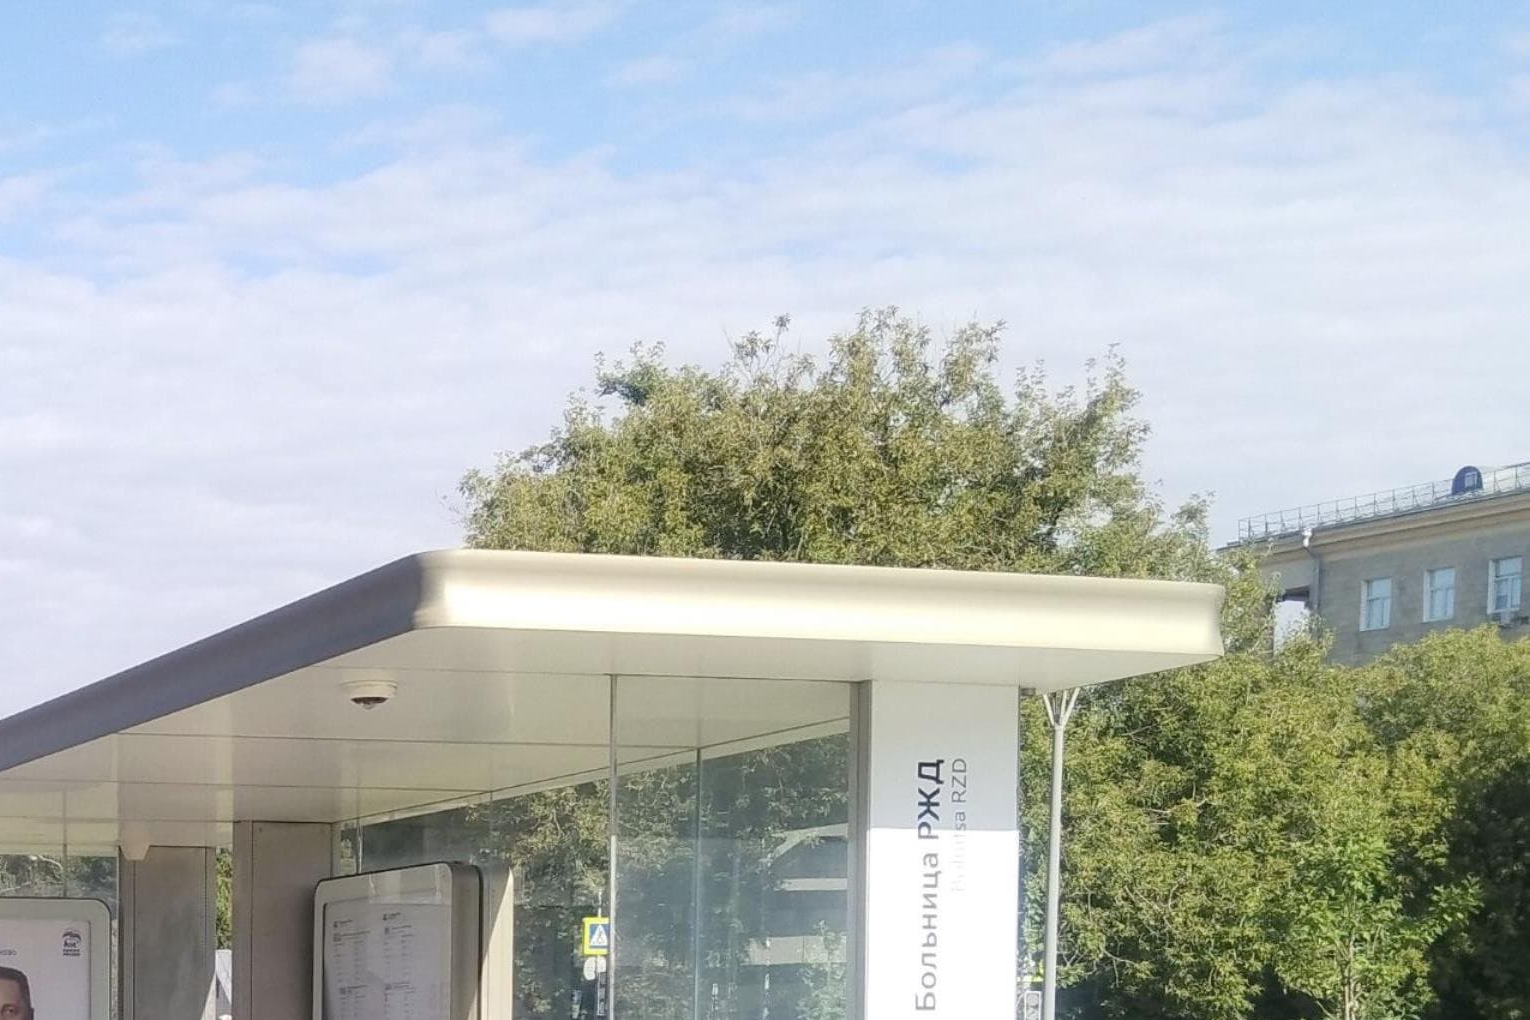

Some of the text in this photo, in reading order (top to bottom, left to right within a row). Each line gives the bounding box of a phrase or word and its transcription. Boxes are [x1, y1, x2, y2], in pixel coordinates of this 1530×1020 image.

[951, 758, 968, 804] RZD
[915, 758, 945, 1012] Больница РЖД
